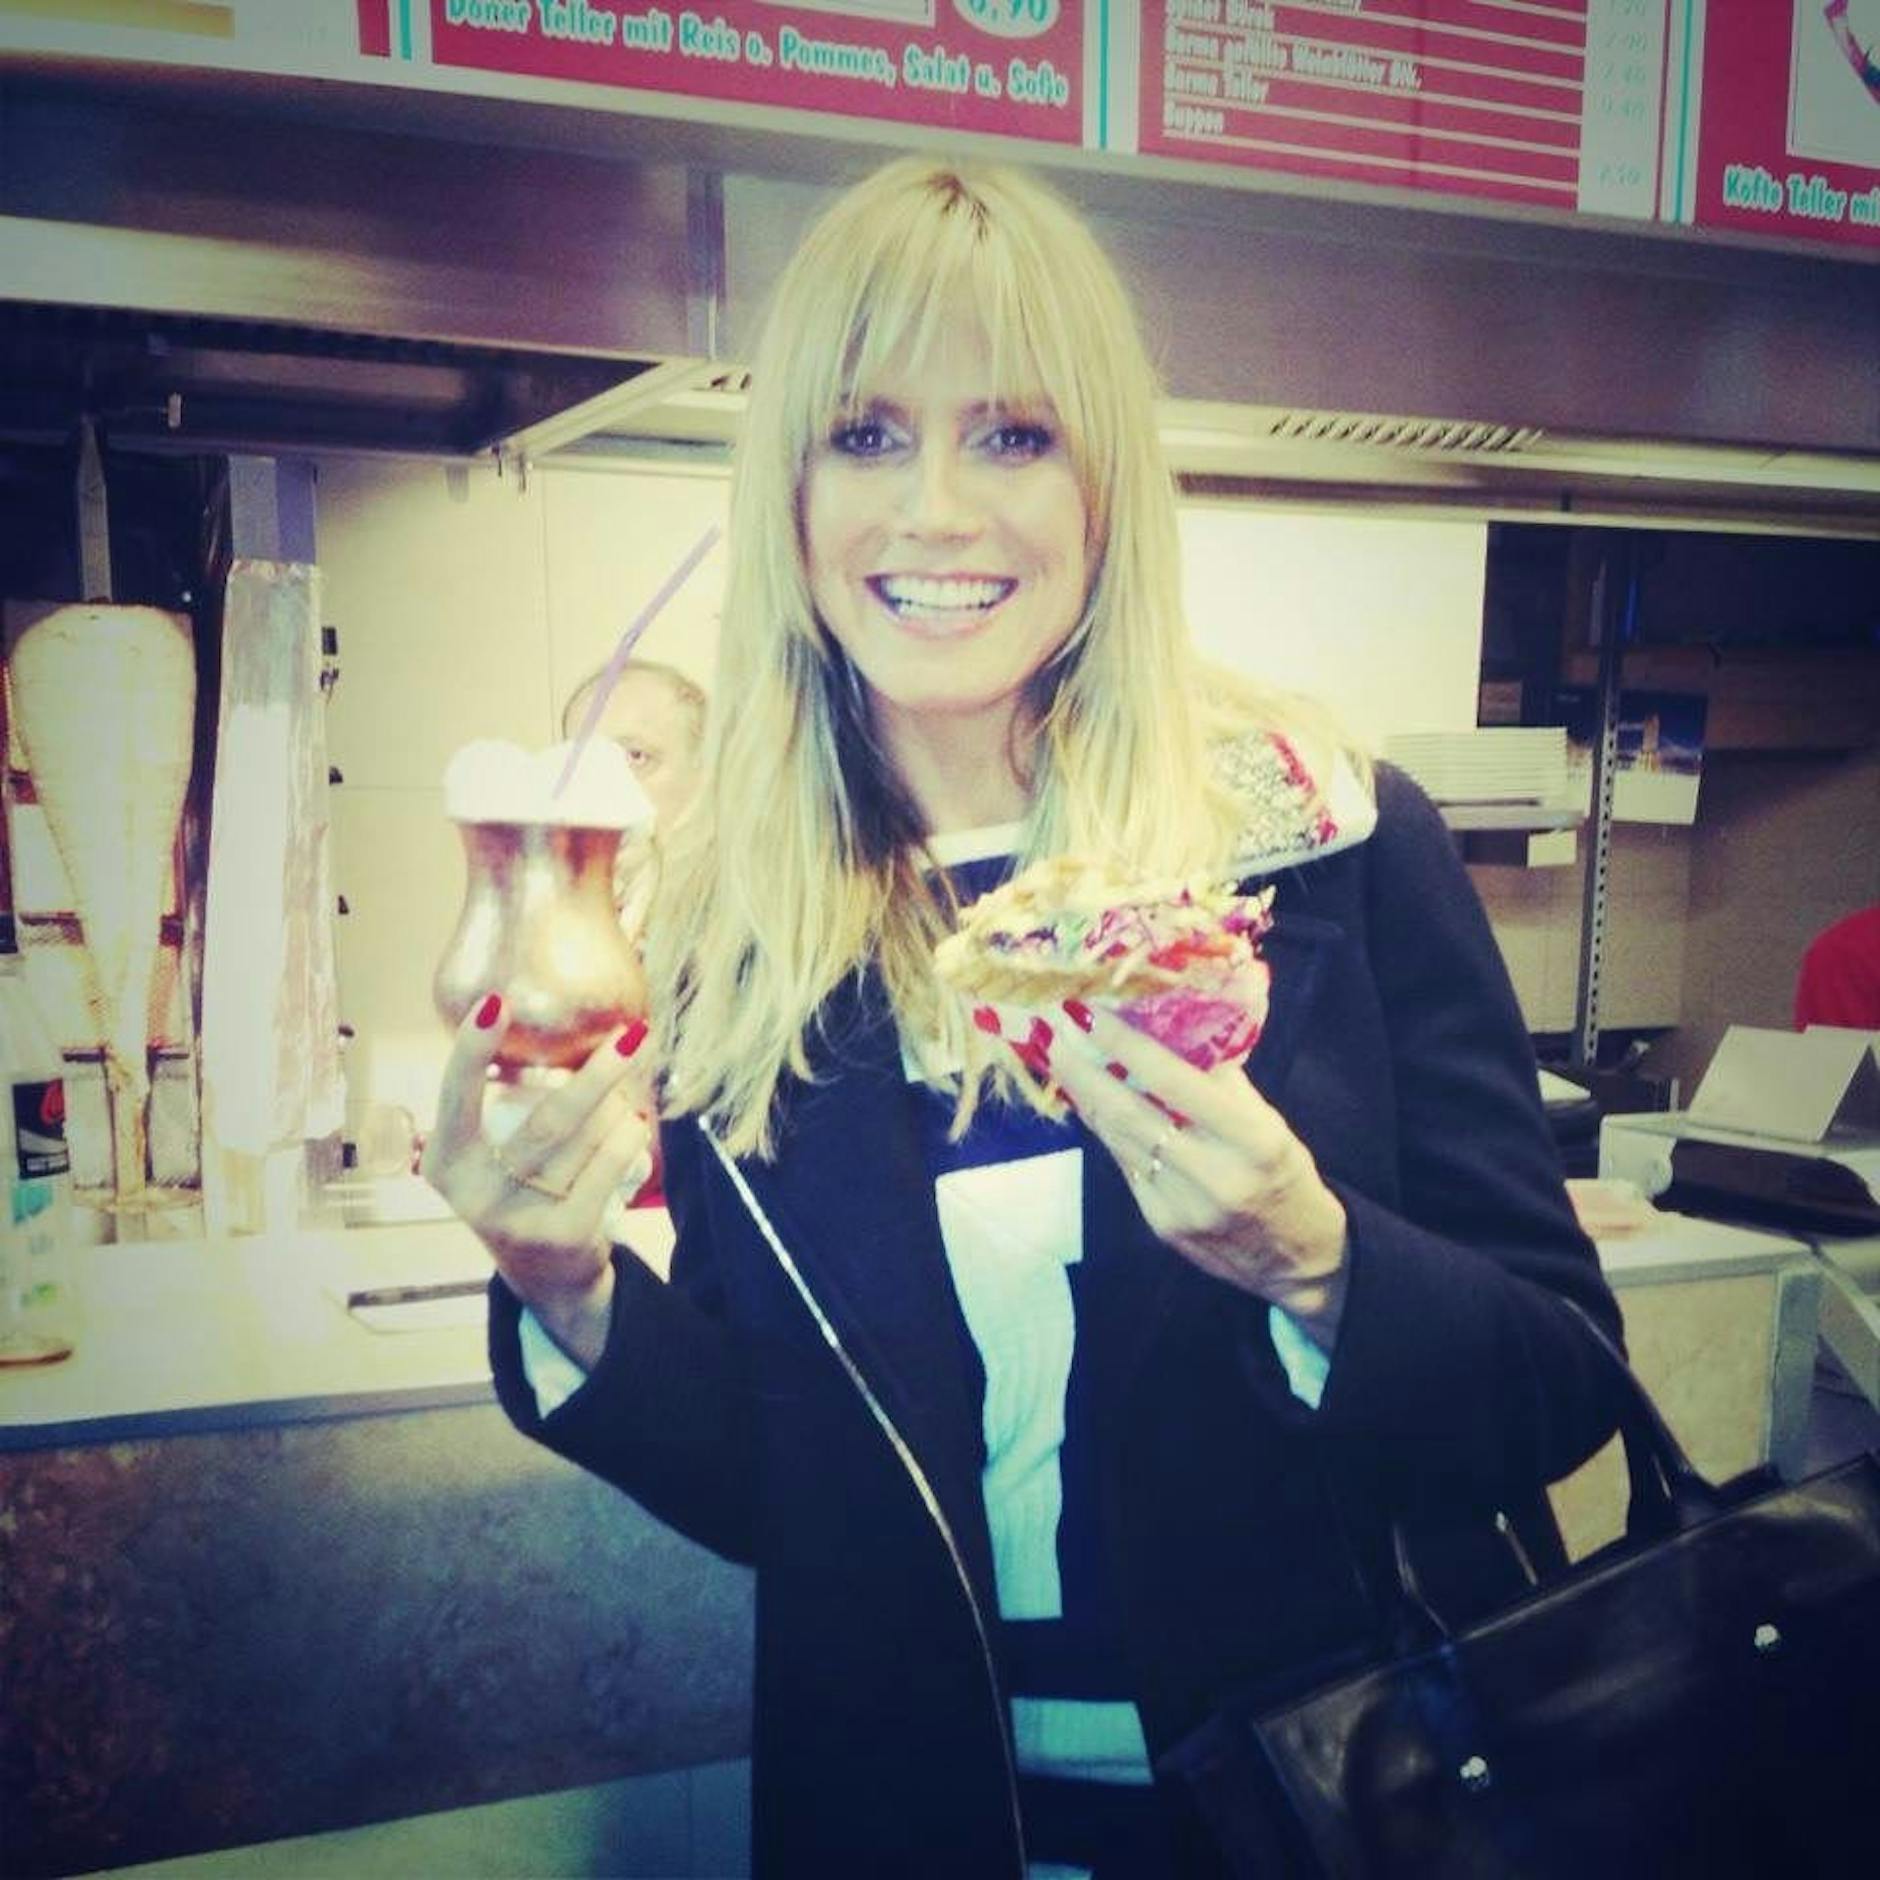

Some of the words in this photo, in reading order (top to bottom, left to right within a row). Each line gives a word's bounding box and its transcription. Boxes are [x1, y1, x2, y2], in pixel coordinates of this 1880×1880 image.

[538, 0, 616, 44] Teller
[622, 9, 671, 52] mit
[680, 14, 740, 61] Reis
[745, 32, 773, 66] o.
[779, 26, 896, 87] Pommes,
[903, 44, 970, 93] Salat
[975, 63, 1002, 98] u.
[1007, 58, 1069, 107] Soße
[1787, 173, 1848, 222] Teller
